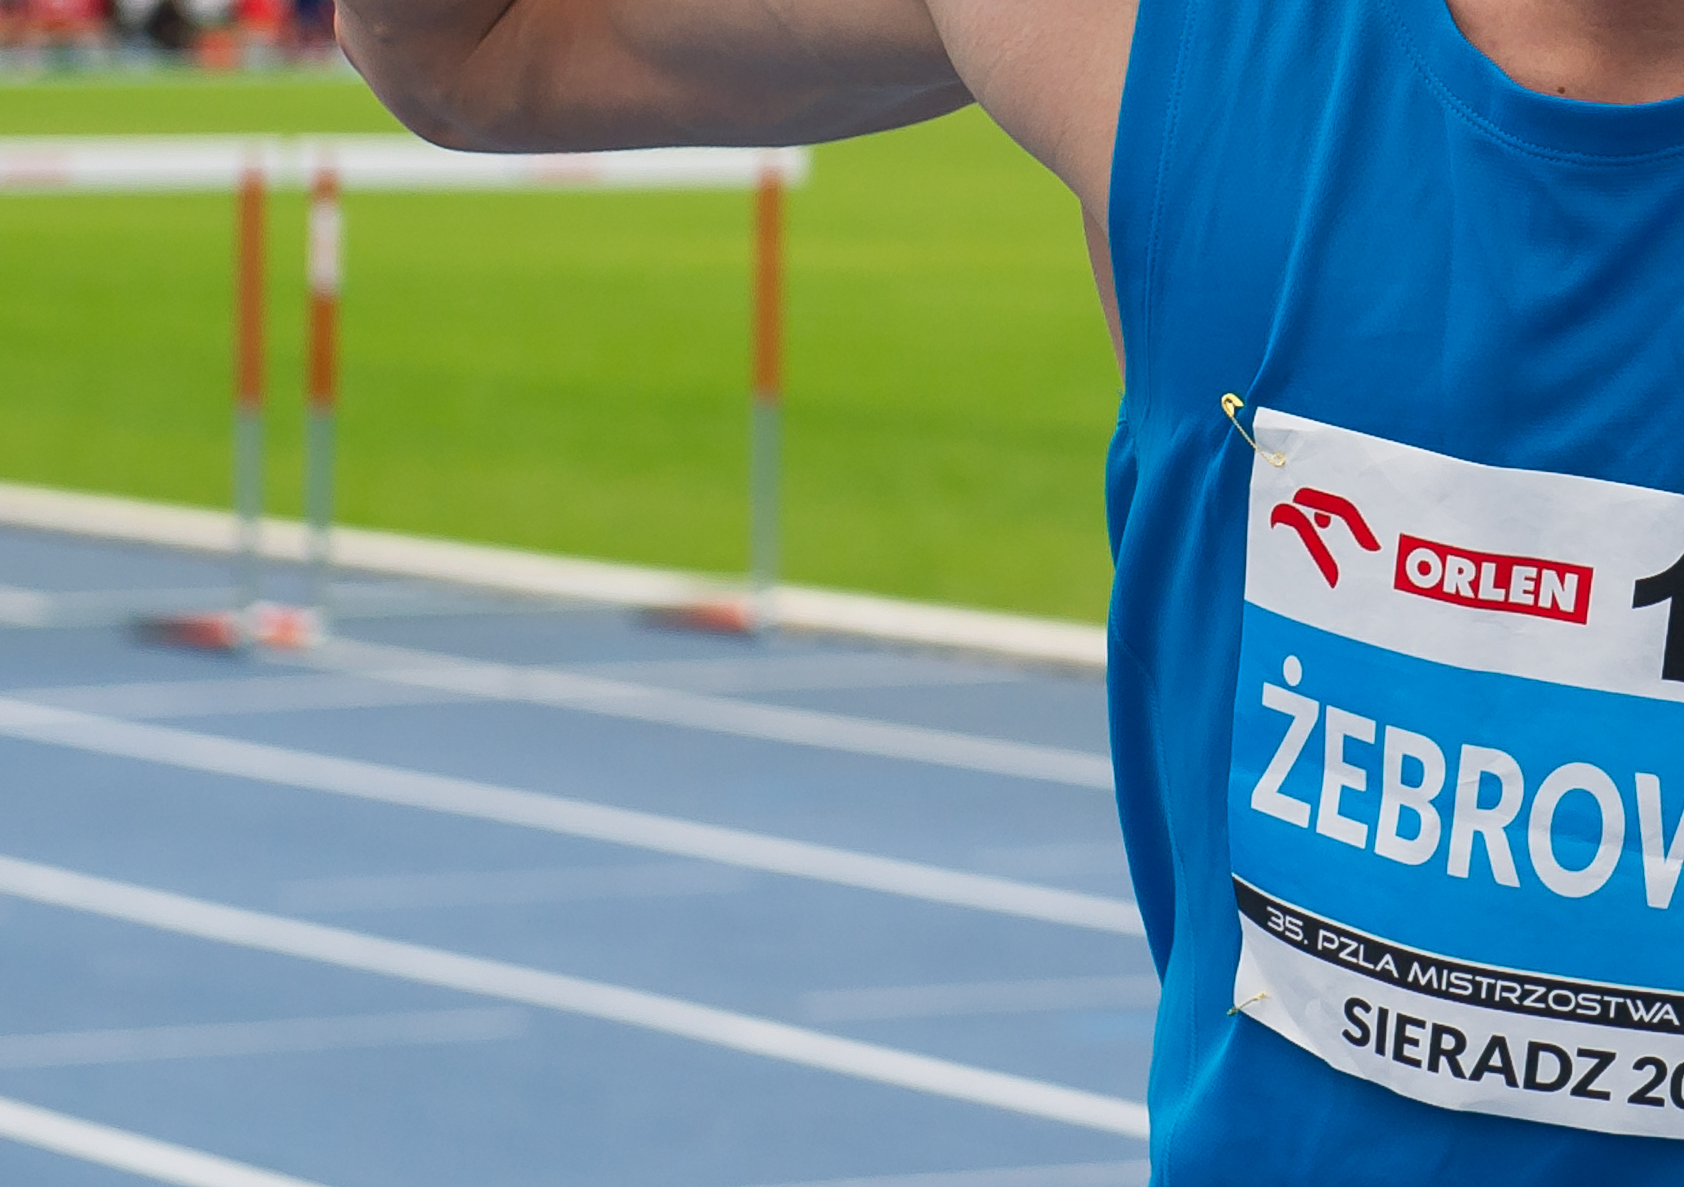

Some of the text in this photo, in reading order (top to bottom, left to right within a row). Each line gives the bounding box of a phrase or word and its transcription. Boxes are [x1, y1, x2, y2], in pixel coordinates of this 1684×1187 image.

[1404, 546, 1580, 614] ORLEN
[1265, 905, 1309, 945] 35.
[1317, 928, 1399, 979] PZLA
[1407, 961, 1681, 1027] MISTRZOSTWA
[1341, 997, 1617, 1102] SIERADZ
